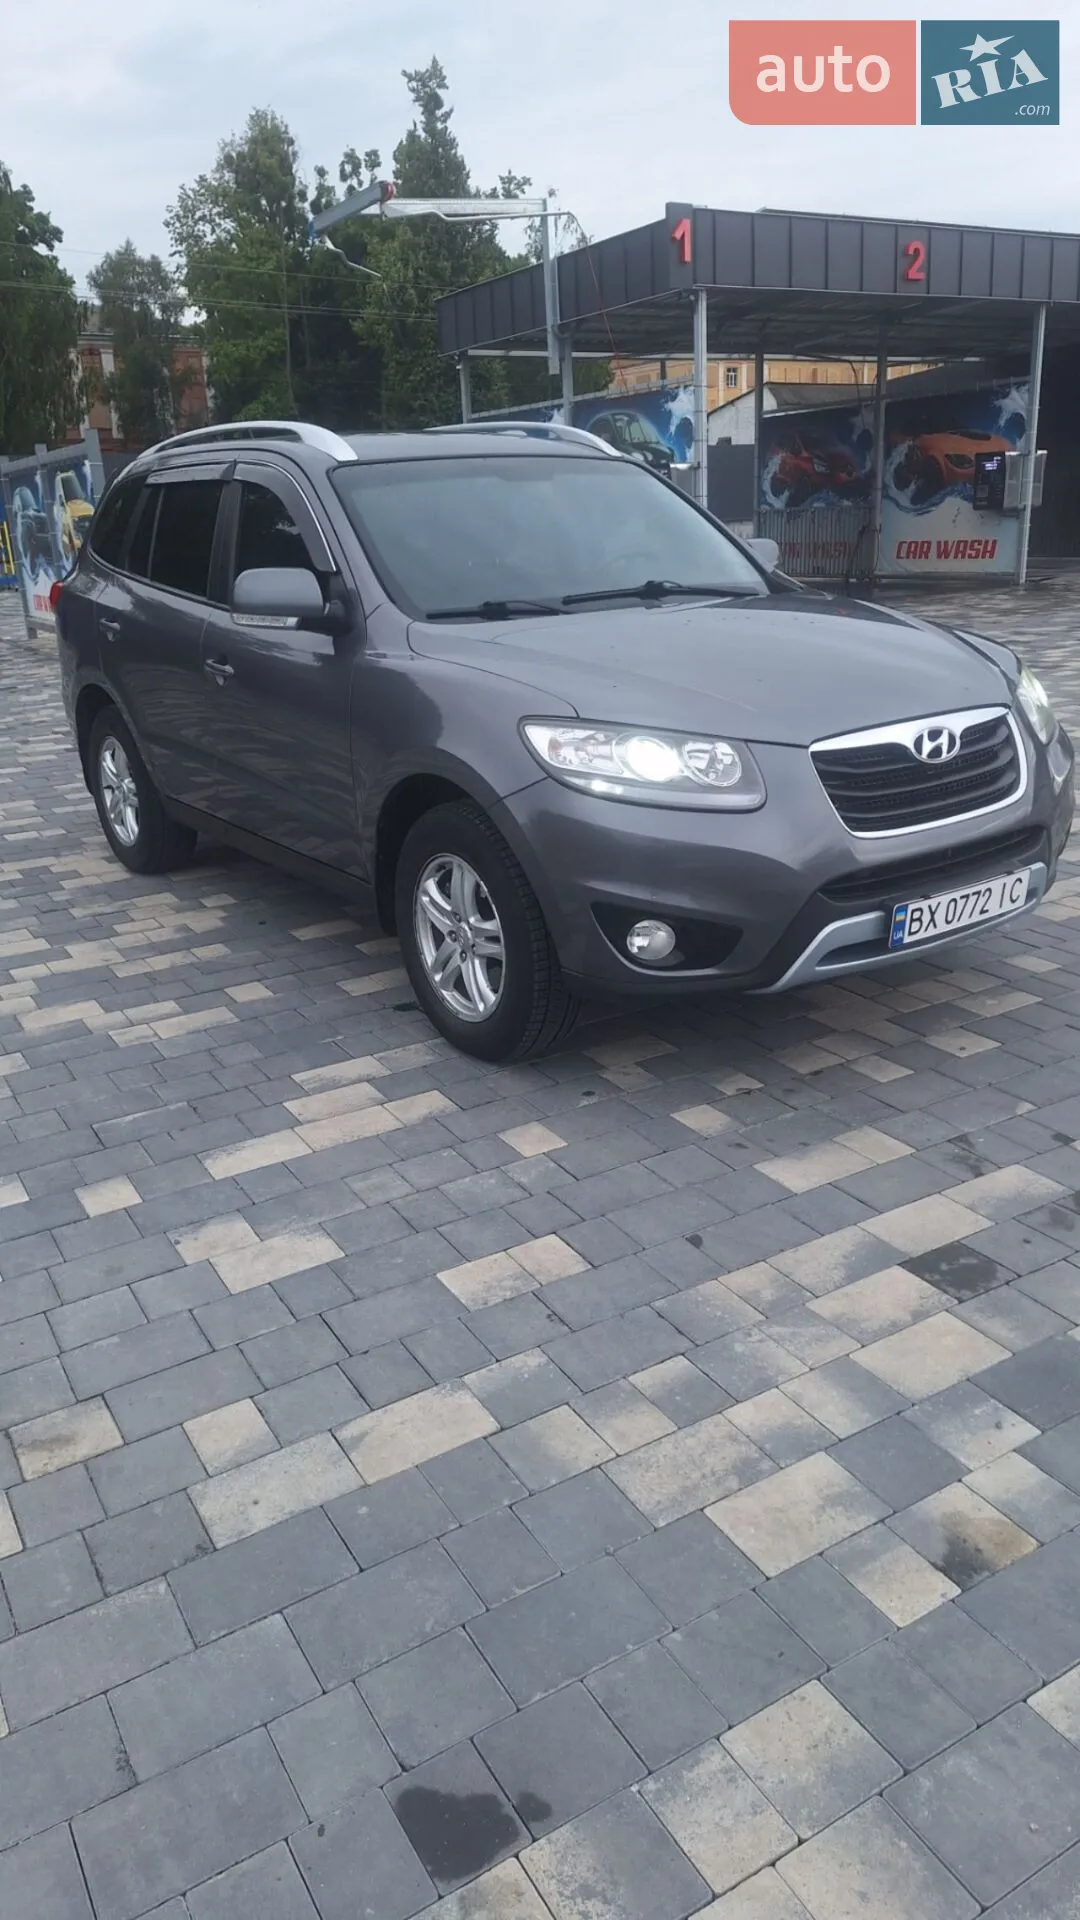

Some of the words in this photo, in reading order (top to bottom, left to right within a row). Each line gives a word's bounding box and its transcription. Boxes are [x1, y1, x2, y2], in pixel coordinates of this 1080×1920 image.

[672, 218, 692, 264] 1
[905, 240, 925, 281] 2
[896, 540, 932, 559] CAR
[936, 539, 997, 559] WASH
[944, 887, 992, 925] 0772
